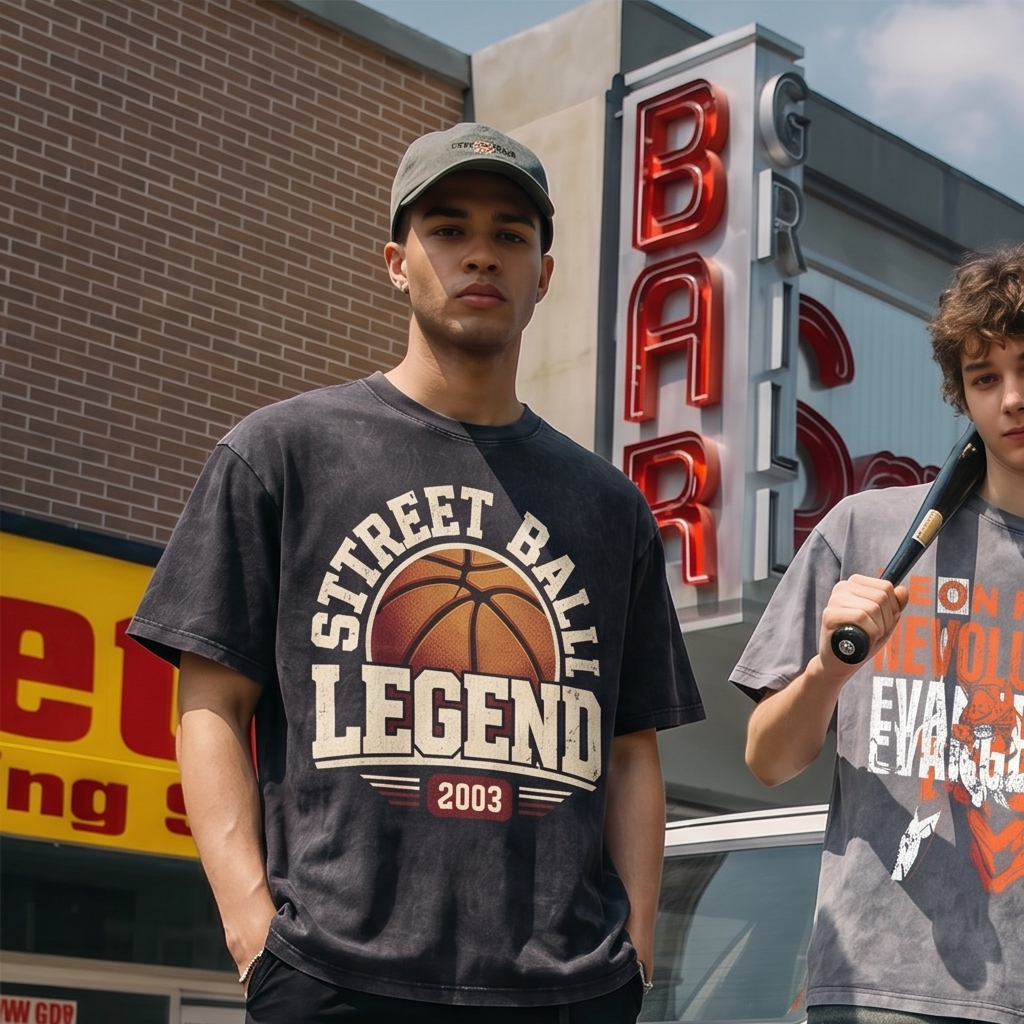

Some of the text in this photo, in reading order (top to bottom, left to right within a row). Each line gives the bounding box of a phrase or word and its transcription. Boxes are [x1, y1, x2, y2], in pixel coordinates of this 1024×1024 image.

[623, 78, 730, 586] BAR
[311, 485, 494, 652] STREET
[908, 573, 999, 618] EON
[312, 664, 602, 783] LEGEND
[437, 781, 502, 813] 2003
